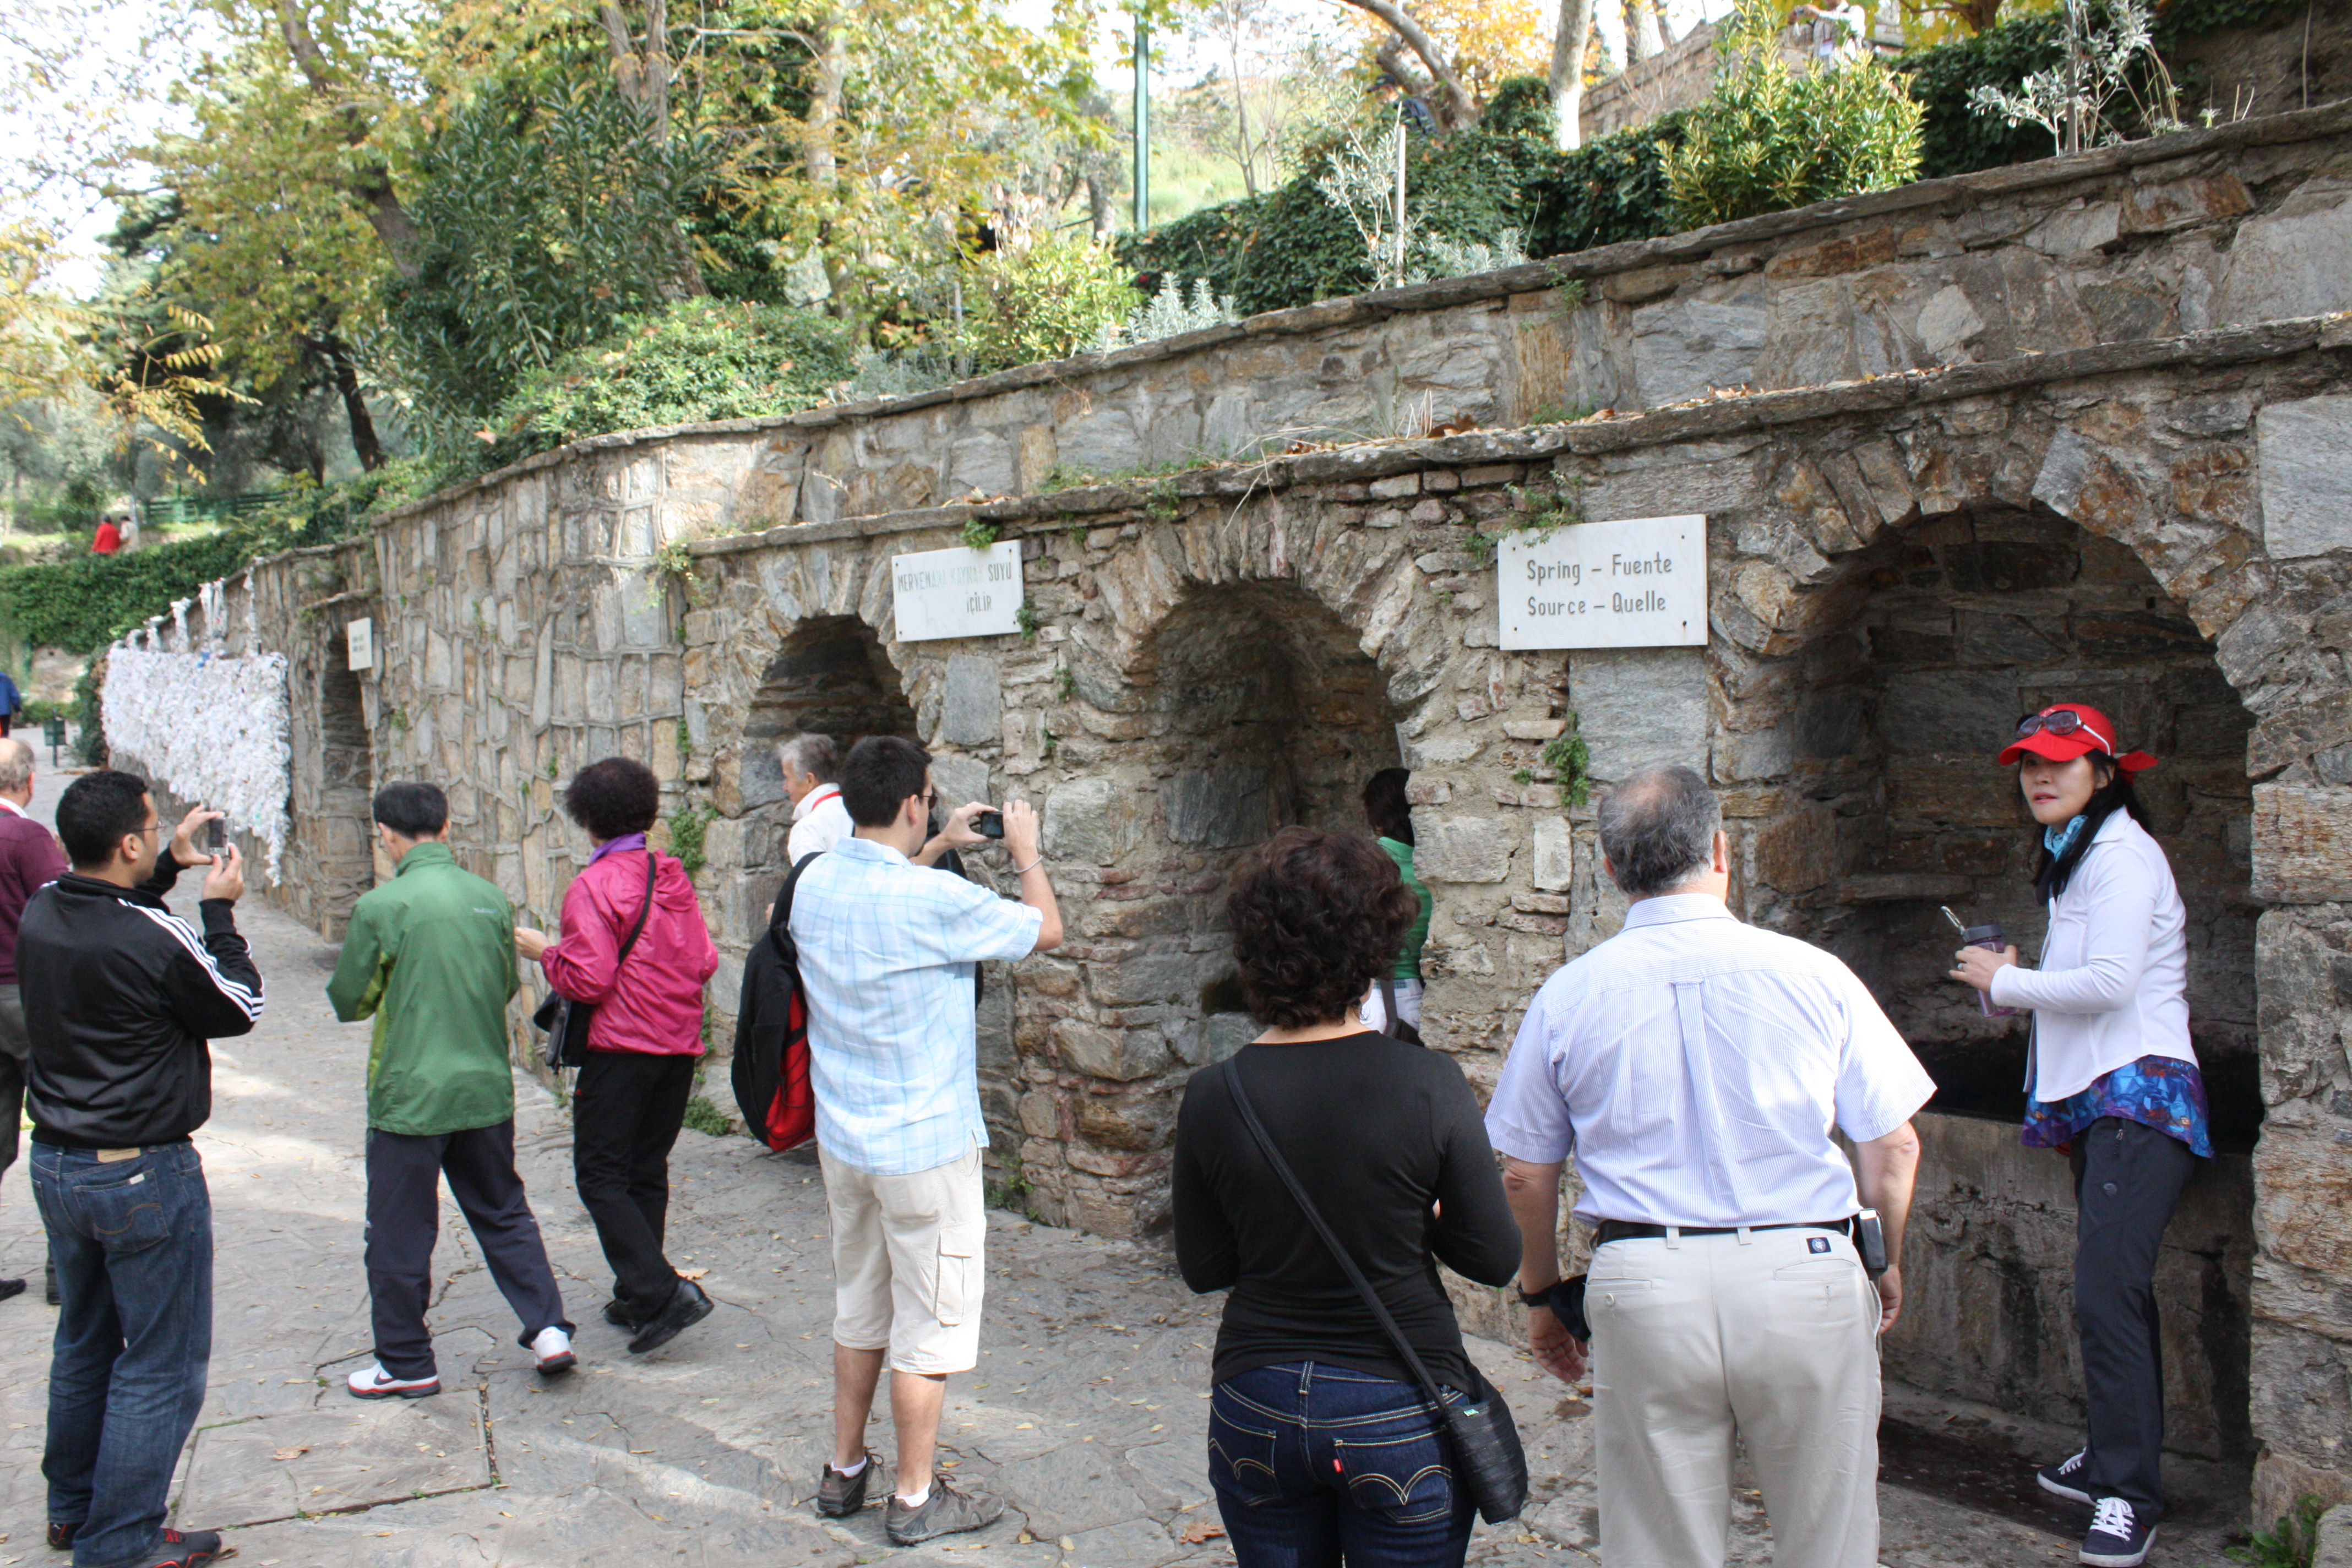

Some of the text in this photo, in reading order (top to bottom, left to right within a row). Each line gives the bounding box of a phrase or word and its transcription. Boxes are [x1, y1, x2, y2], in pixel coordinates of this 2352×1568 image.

[950, 564, 983, 586] KAYNA
[988, 562, 1012, 582] SUYU
[1527, 559, 1581, 585] Spring
[1612, 552, 1672, 576] Fuente
[1527, 596, 1586, 616] Source
[1612, 590, 1666, 614] Quelle
